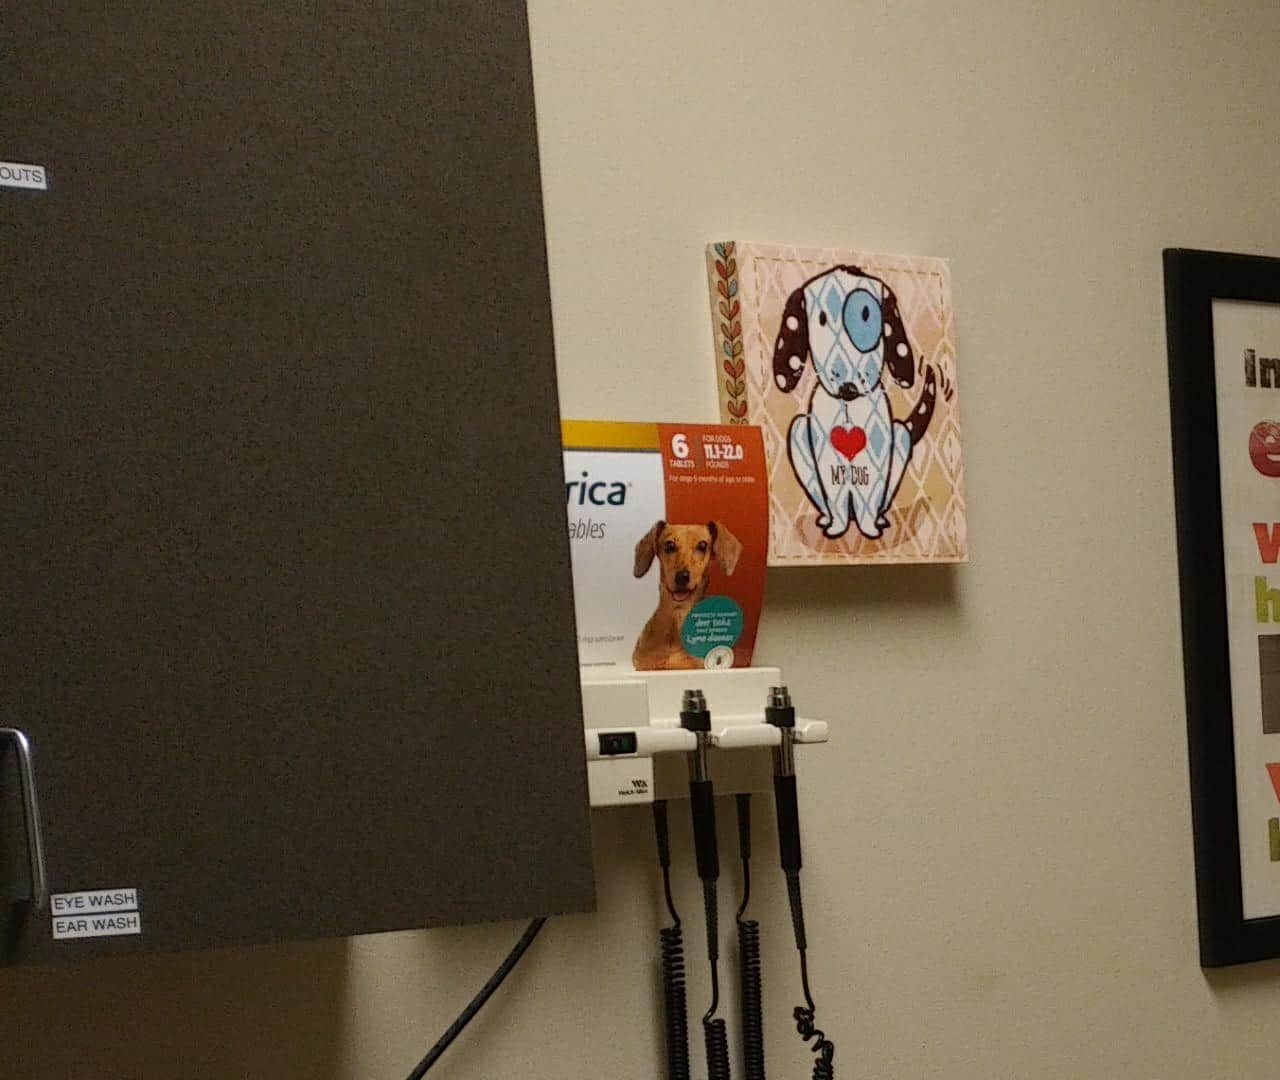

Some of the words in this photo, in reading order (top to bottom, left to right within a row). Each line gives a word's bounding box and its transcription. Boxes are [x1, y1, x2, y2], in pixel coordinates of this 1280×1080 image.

[672, 433, 689, 459] 6
[830, 464, 846, 486] MY
[850, 465, 869, 486] DOG
[54, 896, 84, 910] EYE
[88, 892, 135, 907] WASH
[56, 920, 88, 934] EAR
[92, 916, 137, 930] WASH
